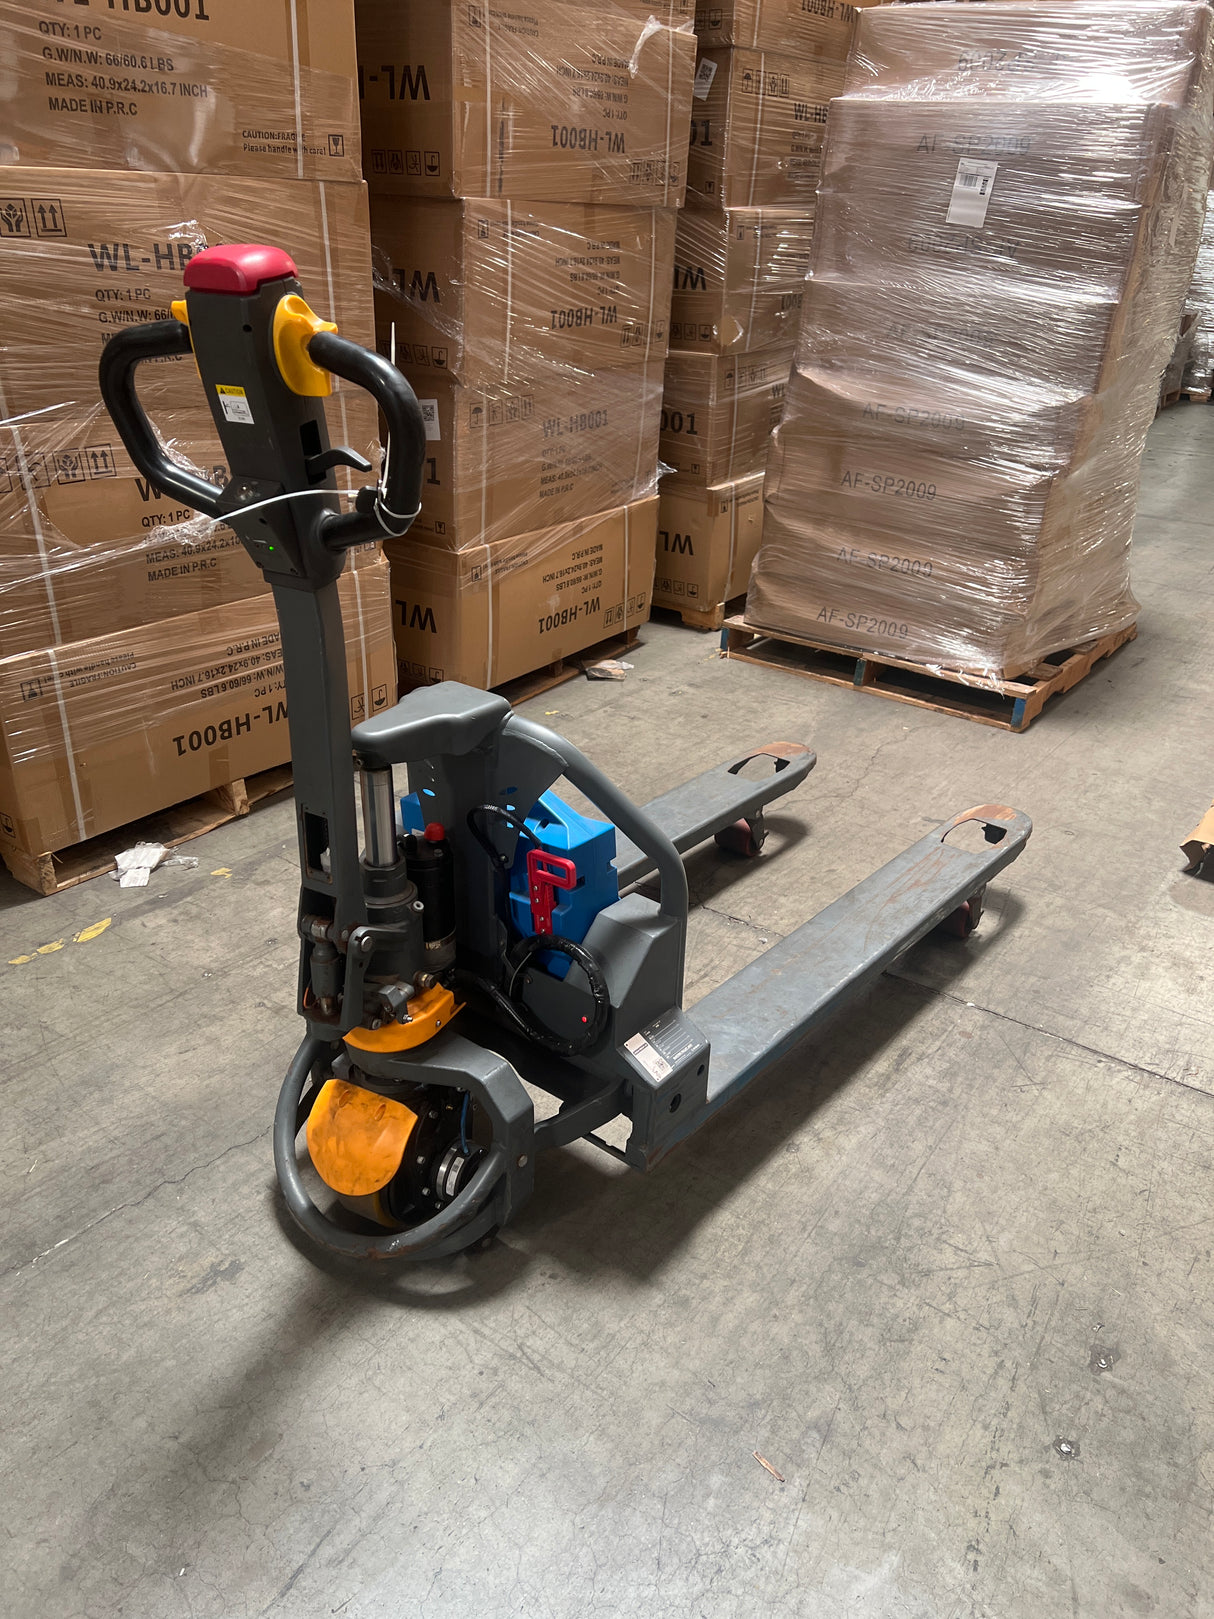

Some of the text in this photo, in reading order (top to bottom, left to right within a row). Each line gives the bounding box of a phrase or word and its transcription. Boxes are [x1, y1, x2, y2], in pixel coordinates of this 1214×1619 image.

[39, 21, 102, 40] QTY: 1 PC
[42, 46, 174, 71] G.W/N.W: 66/60.6 LBS
[45, 72, 208, 98] MEAS: 40.9x24.2x16.7 INCH
[358, 65, 431, 100] WL-
[49, 97, 138, 116] MADE IN P.R.C
[293, 146, 308, 154] wh
[551, 125, 625, 153] WL-HB001
[95, 289, 151, 302] QTY: 1 PC
[551, 306, 617, 330] WL-HB001
[841, 470, 937, 501] AF-SP2009
[142, 509, 190, 527] QTY: 1 PC
[147, 558, 217, 582] MADE IN P.R.C
[837, 547, 933, 578] AF-SP2009
[539, 597, 600, 634] WL-HB001
[817, 606, 909, 640] AF-SP2009
[227, 632, 280, 655] ADE IN P.R.C
[171, 648, 283, 690] EAS: 40.9x24.2x16.7 INCH
[200, 685, 219, 698] LBS
[220, 676, 251, 691] 66/60.6
[254, 686, 266, 698] PC
